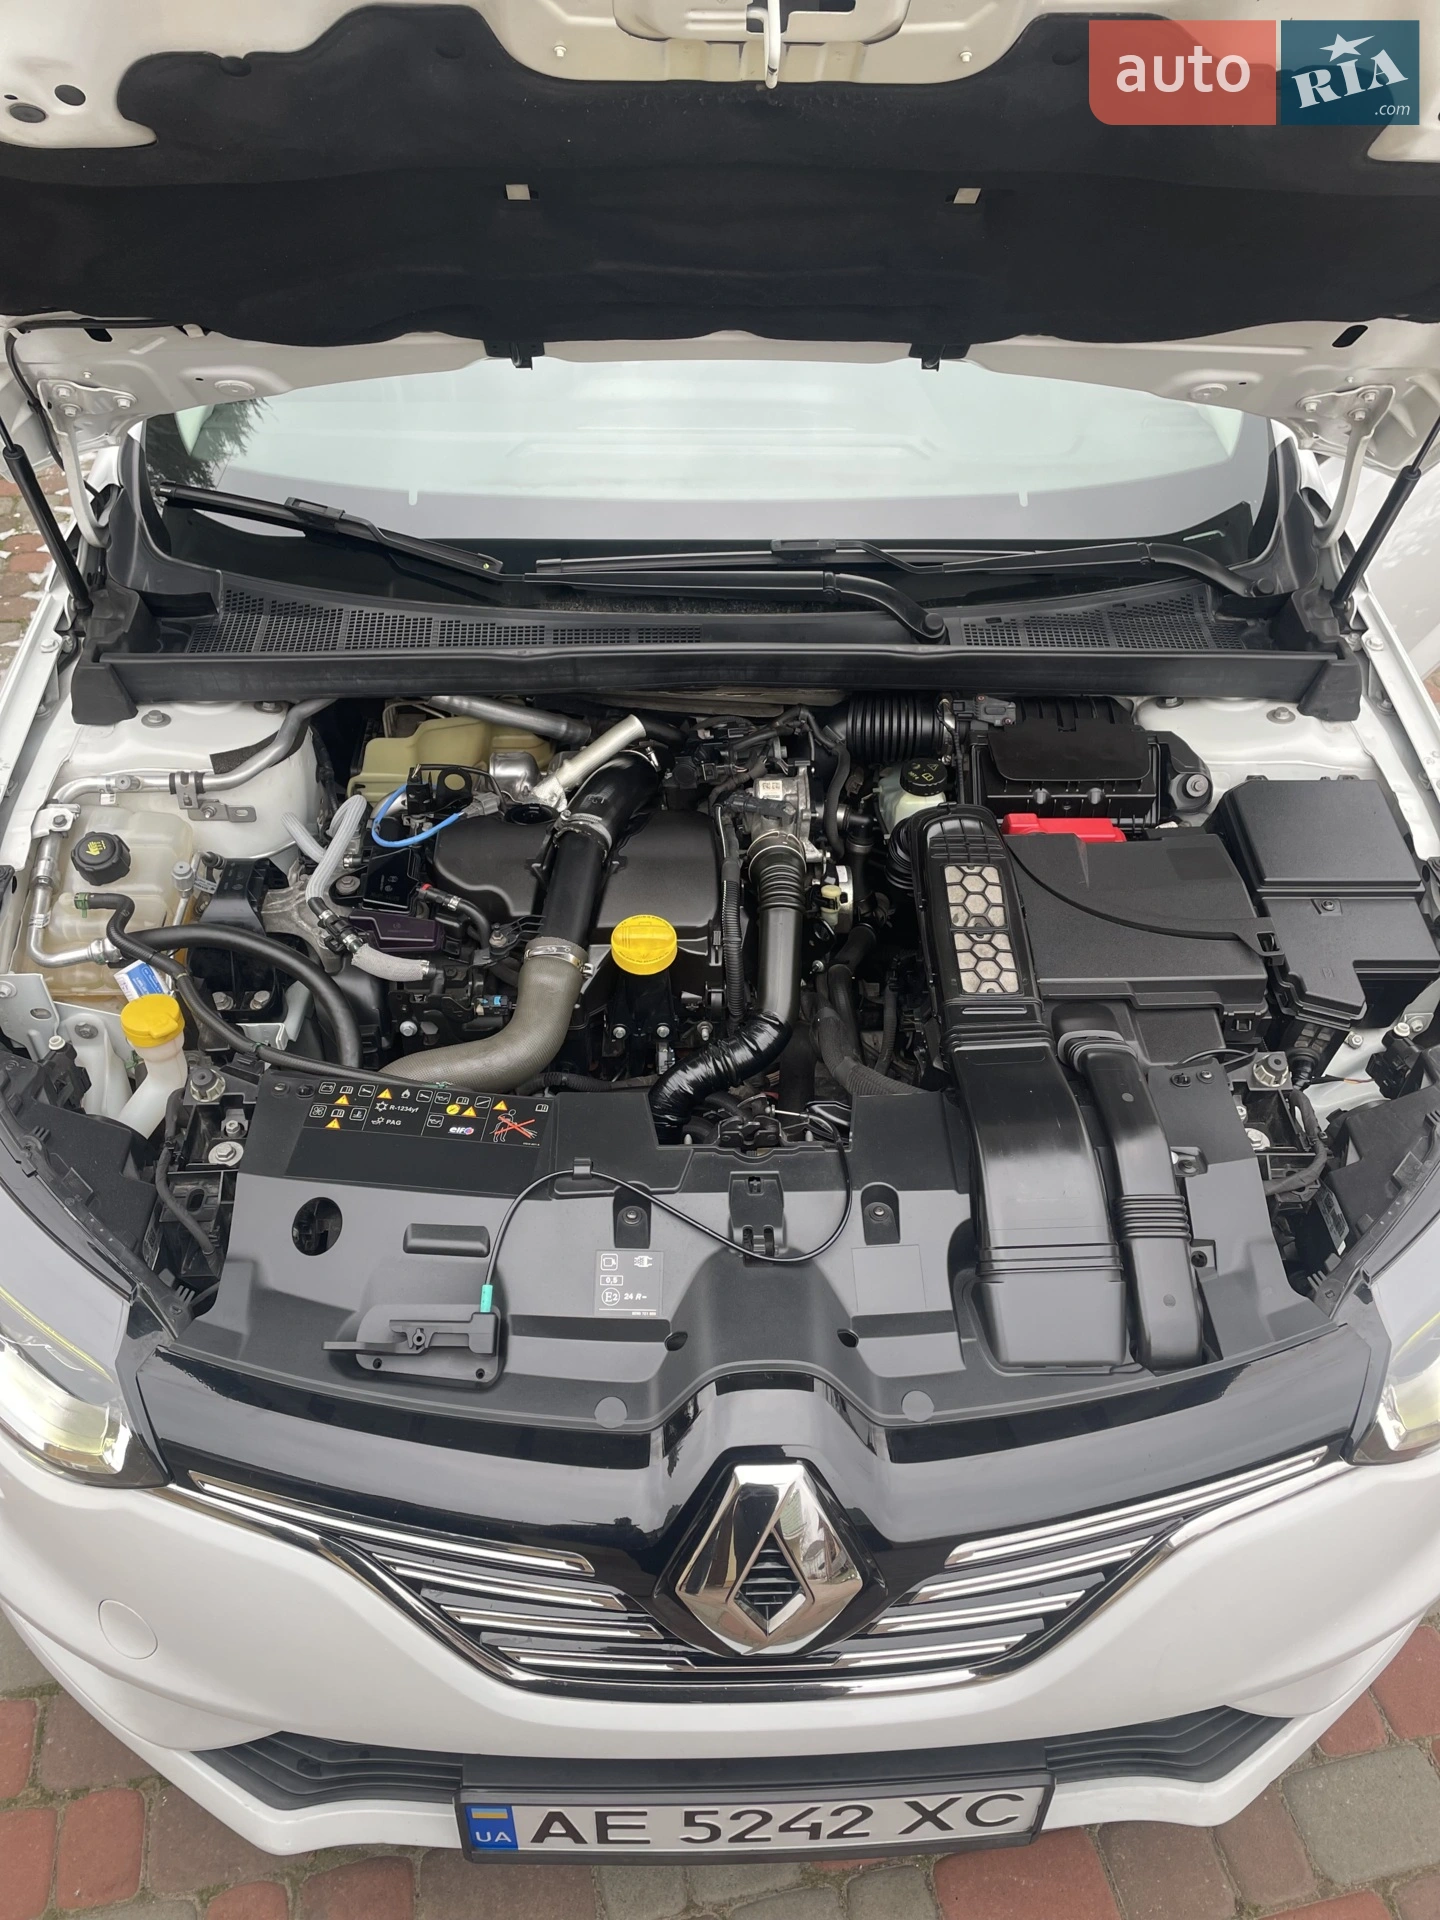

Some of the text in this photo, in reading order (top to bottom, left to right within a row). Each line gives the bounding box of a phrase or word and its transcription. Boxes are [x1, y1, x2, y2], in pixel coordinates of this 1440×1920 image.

[389, 1104, 419, 1114] R-1234yf
[385, 1118, 402, 1126] PAG
[604, 1291, 618, 1302] E2
[623, 1292, 634, 1300] 24
[529, 1793, 1025, 1845] AE 5242 XC
[475, 1830, 513, 1844] UA
